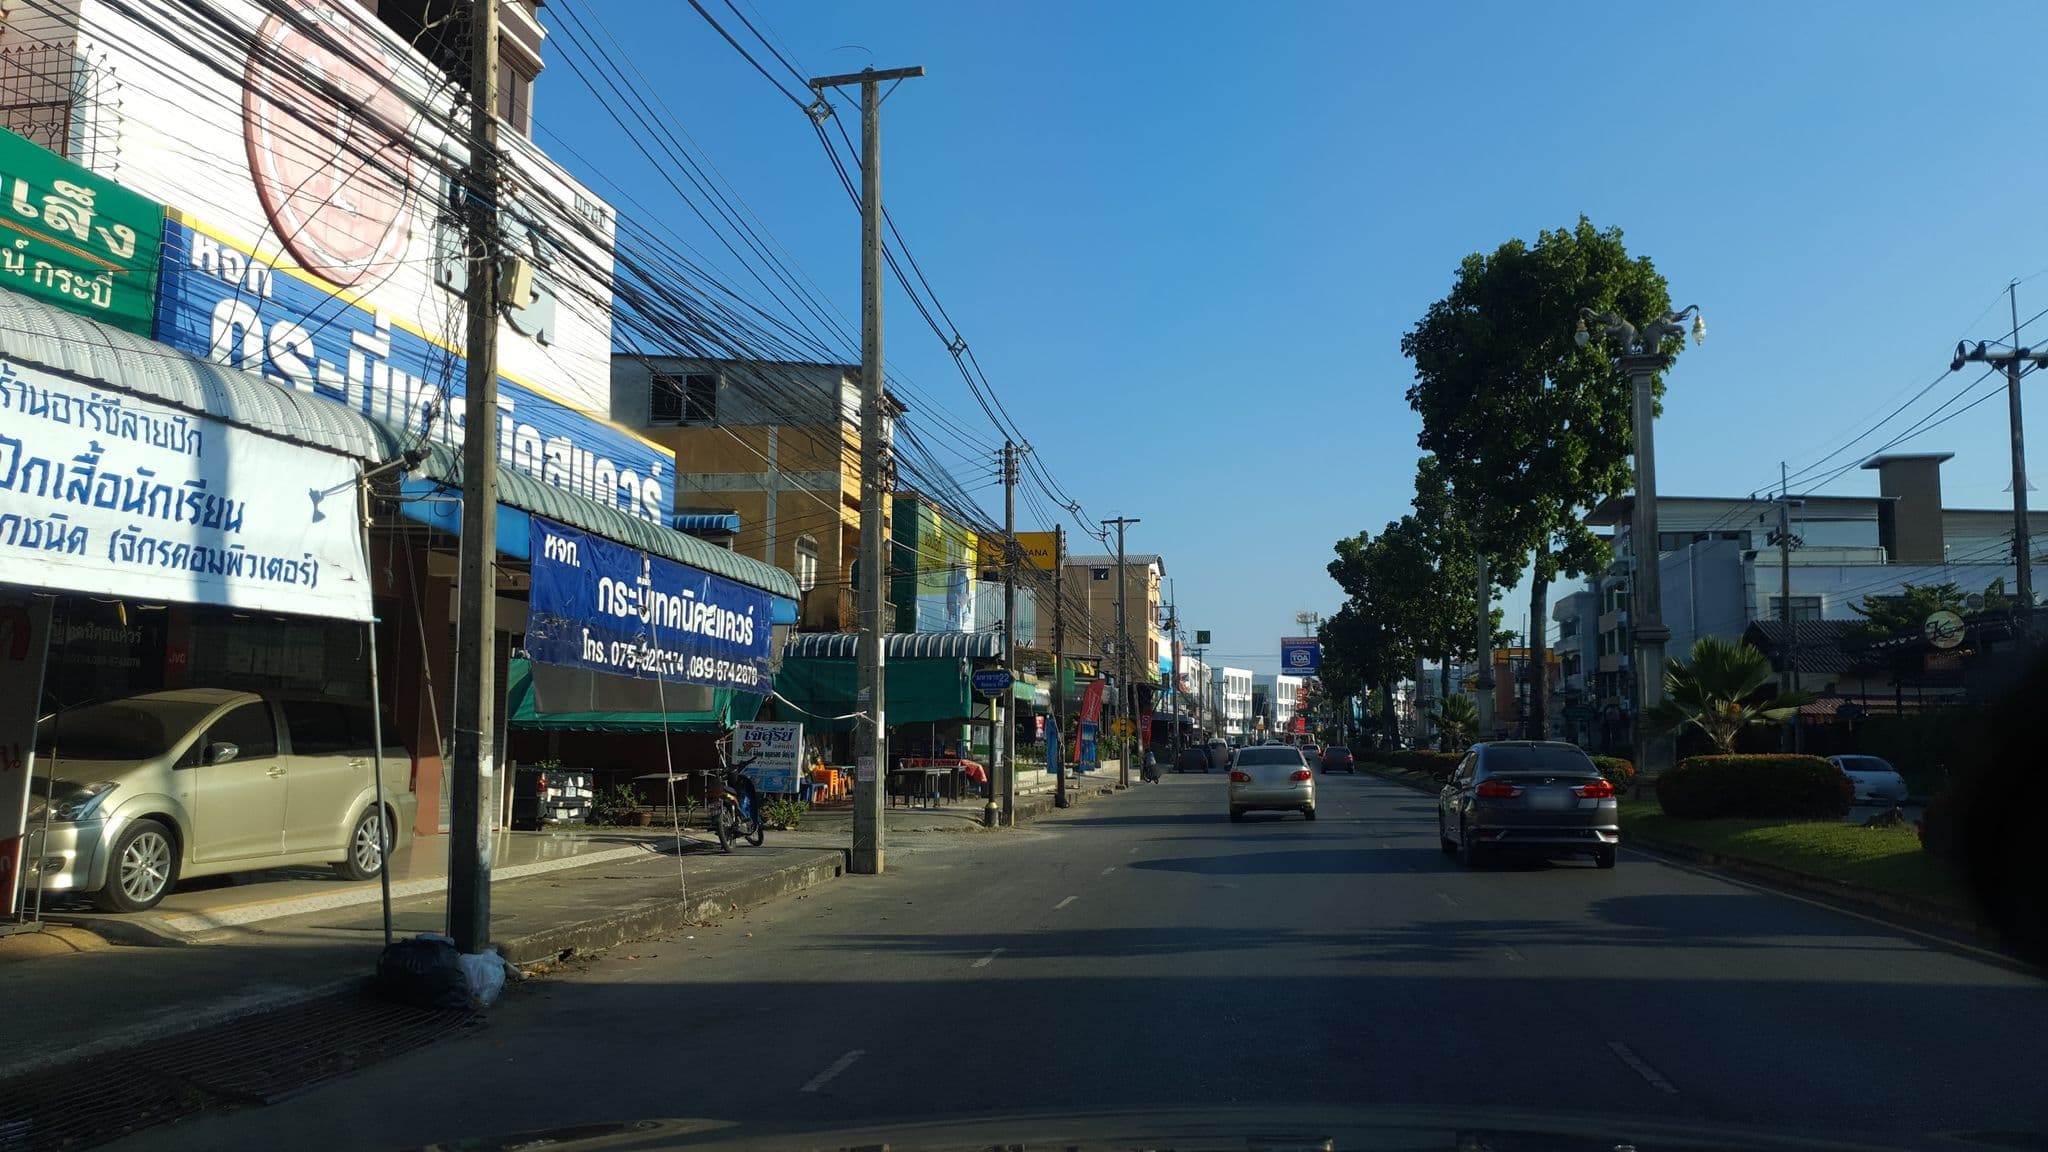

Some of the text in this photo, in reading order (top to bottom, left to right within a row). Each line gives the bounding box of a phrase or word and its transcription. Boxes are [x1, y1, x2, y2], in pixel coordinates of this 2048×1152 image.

[0, 172, 136, 260] เส็ง
[34, 261, 113, 309] กระบี่
[544, 533, 581, 567] หจก.
[597, 560, 754, 646] กระบี่เทคนิคสแควร์
[582, 629, 608, 665] โทร.
